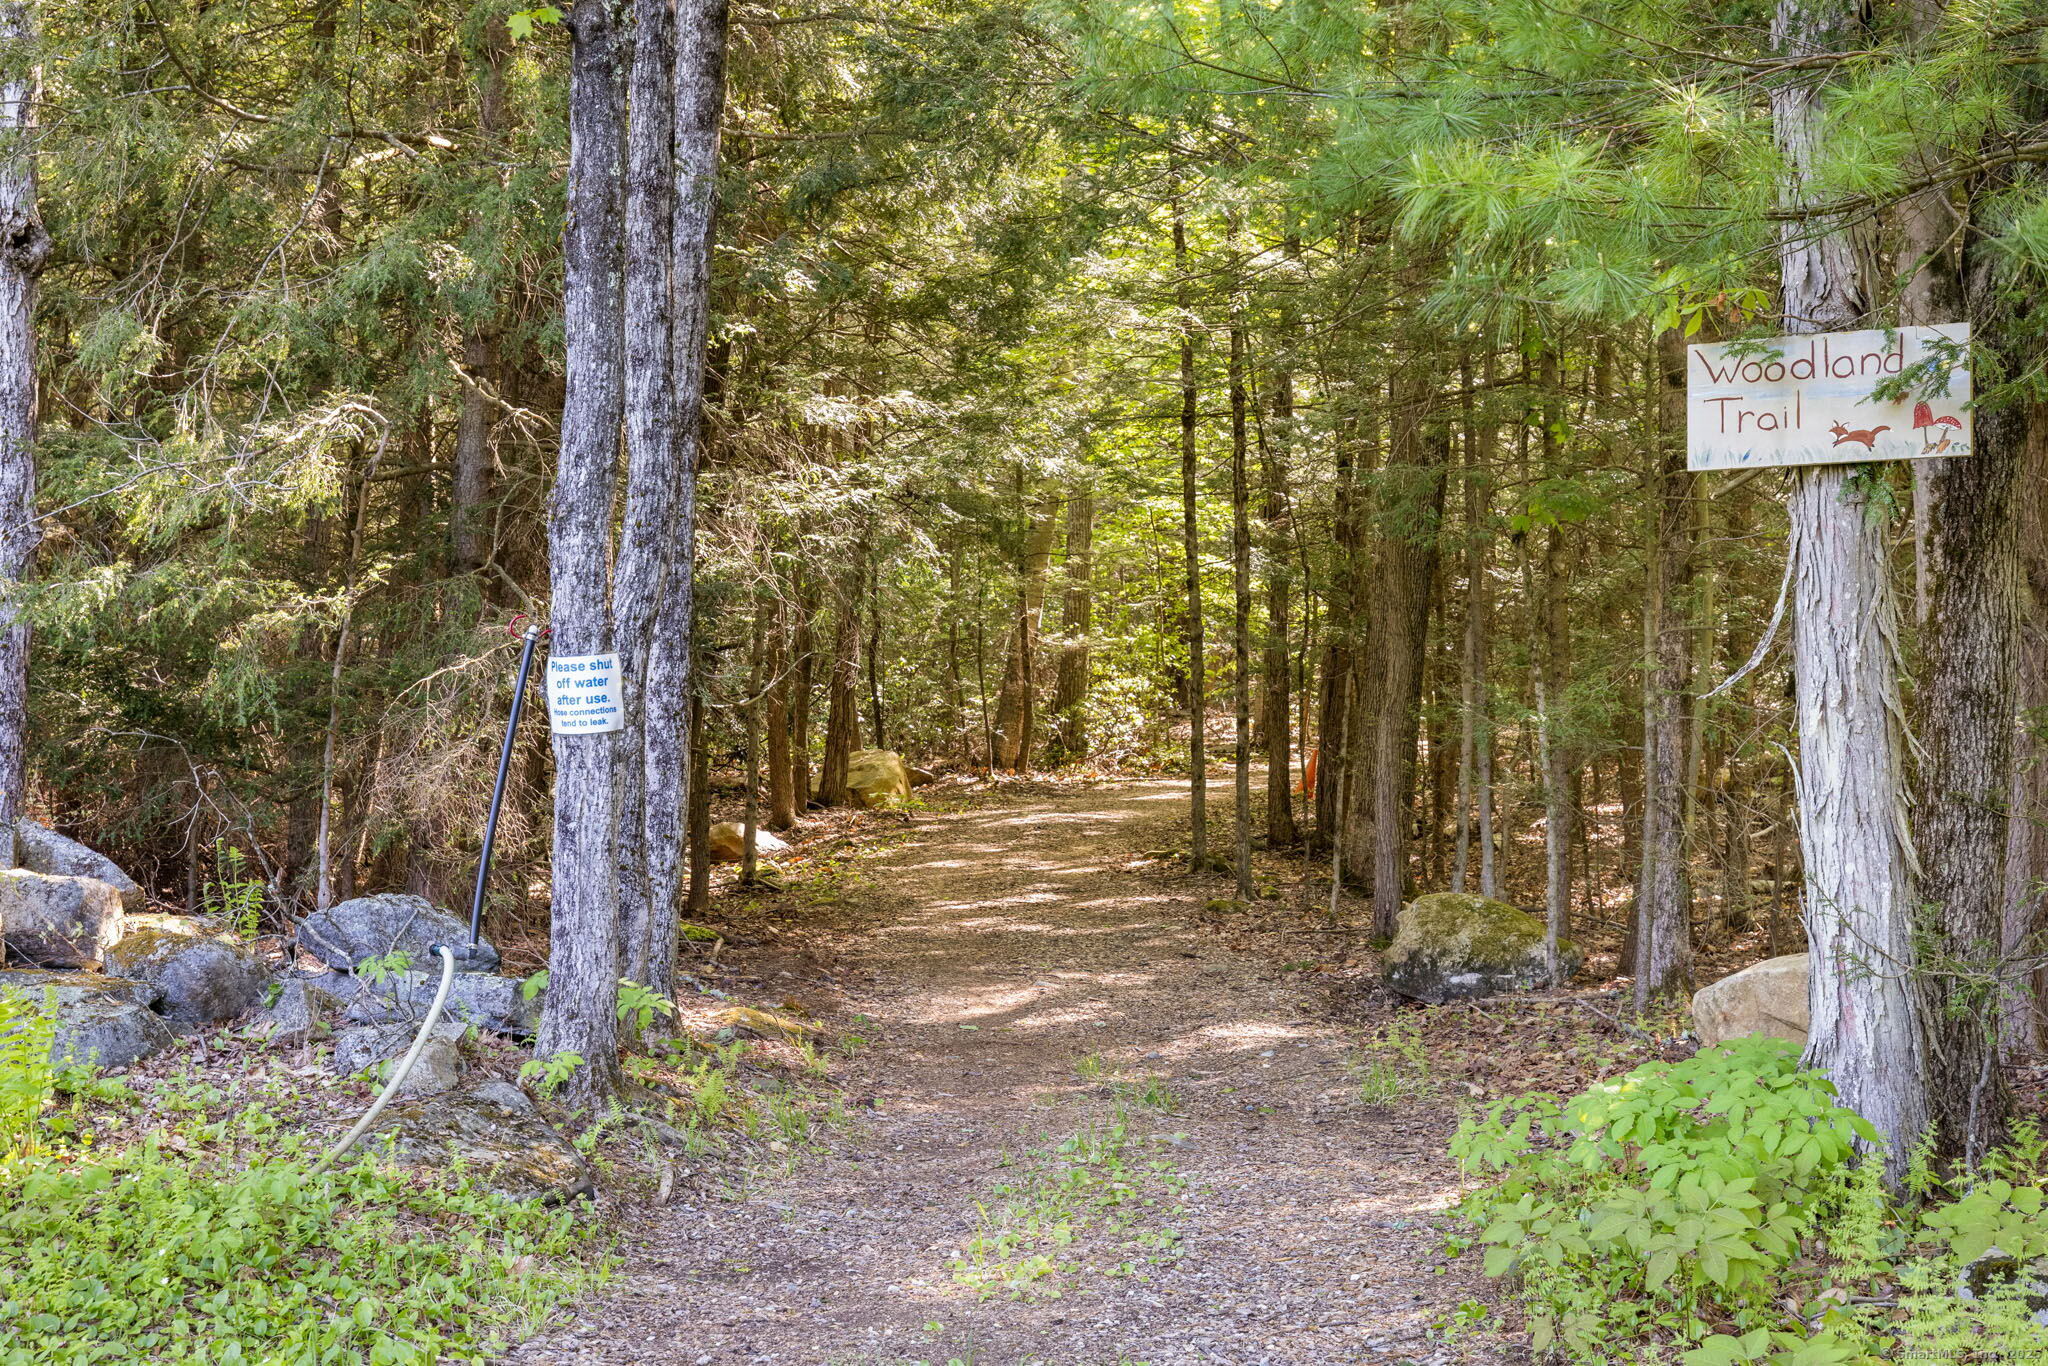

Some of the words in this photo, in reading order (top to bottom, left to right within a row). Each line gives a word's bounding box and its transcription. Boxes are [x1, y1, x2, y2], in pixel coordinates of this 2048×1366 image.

[1695, 333, 1904, 384] Woodland
[1703, 390, 1801, 434] Trail
[551, 661, 585, 672] Please
[589, 659, 613, 671] shut
[556, 678, 571, 688] off
[574, 677, 608, 688] water
[557, 695, 581, 705] after
[586, 694, 610, 704] use.
[569, 706, 617, 716] connections
